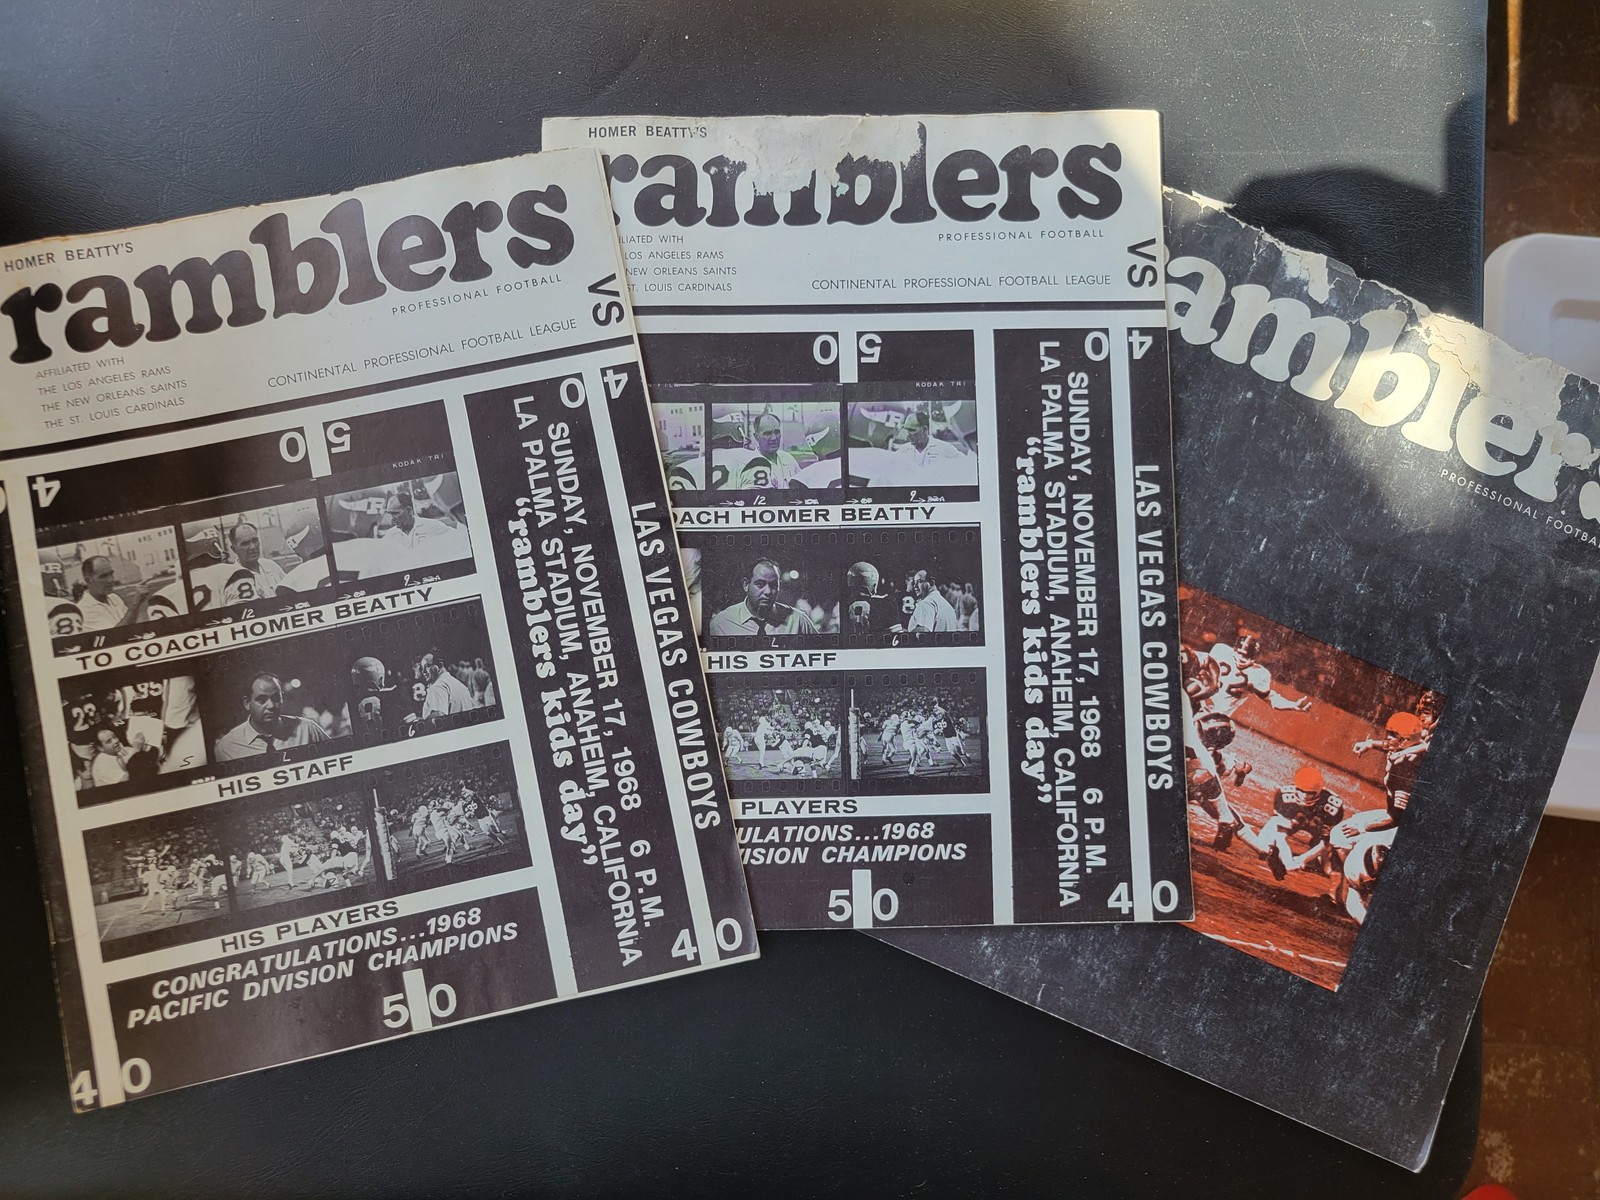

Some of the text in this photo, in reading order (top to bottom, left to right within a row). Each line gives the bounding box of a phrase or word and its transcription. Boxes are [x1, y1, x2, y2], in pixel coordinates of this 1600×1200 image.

[588, 125, 708, 139] HOMER BEATTY'S
[618, 235, 684, 244] ILIATED WITH
[624, 251, 724, 260] LOS ANGELES RAMS
[938, 229, 1105, 242] PROFESSIONAL FOOTBALL
[1, 184, 575, 364] ramblers
[4, 242, 134, 272] HOMER BEATTY'S
[625, 267, 737, 276] NEW ORLEANS SAINTS
[1126, 237, 1158, 289] VS
[392, 275, 562, 316] PROFESSIONAL FOOTBALL
[588, 273, 625, 327] VS
[644, 283, 673, 292] LOUIS
[677, 283, 733, 292] CARDINALS
[811, 273, 1112, 291] CONTINENTAL PROFESSIONAL FOOTBALL LEAGUE
[35, 357, 125, 380] AFFILIATED WITH
[268, 319, 577, 388] CONTINENTAL PROFESSIONAL FOOTBALL LEAGUE
[38, 366, 171, 396] THE LOS ANGELES RAMS
[41, 380, 188, 413] THE NEW ORLEANS SAINTS
[1163, 244, 1600, 527] ambler
[44, 397, 185, 429] THE ST. LOUIS CARDINALS
[392, 458, 422, 469] KODAK
[672, 506, 936, 525] ACH HOMER BEATTY
[1440, 468, 1600, 549] PROFESSIONAL FOOTBA
[1072, 494, 1098, 636] NOVEMBER
[76, 586, 434, 670] TO COACH HOMER BEATTY
[572, 543, 618, 690] NOVEMBER
[1039, 341, 1081, 907] LA PALMA STADIUM, ANAHEIM, CALIFORNIA
[1134, 464, 1173, 790] LAS VEGAS COWBOYS
[513, 396, 642, 967] LA PALMA STADIUM, ANAHEIM, CALIFORNIA
[631, 501, 721, 830] LAS VEGAS COWBOYS
[707, 653, 836, 670] HIS STAFF
[1022, 626, 1049, 704] kids
[1075, 648, 1099, 683] 17,
[541, 687, 577, 768] kids
[602, 699, 626, 737] 17,
[1078, 696, 1101, 758] 1968
[218, 755, 355, 798] HIS STAFF
[611, 746, 641, 811] 1968
[1082, 787, 1103, 804] 6
[741, 799, 858, 816] PLAYERS
[629, 839, 651, 858] 6
[821, 843, 967, 864] CHAMPIONS
[1084, 817, 1107, 874] P.M.
[635, 868, 664, 927] P.M.
[220, 900, 400, 953] HIS PLAYERS
[127, 922, 519, 1028] PACIFIC DIVISION CHAMPIONS
